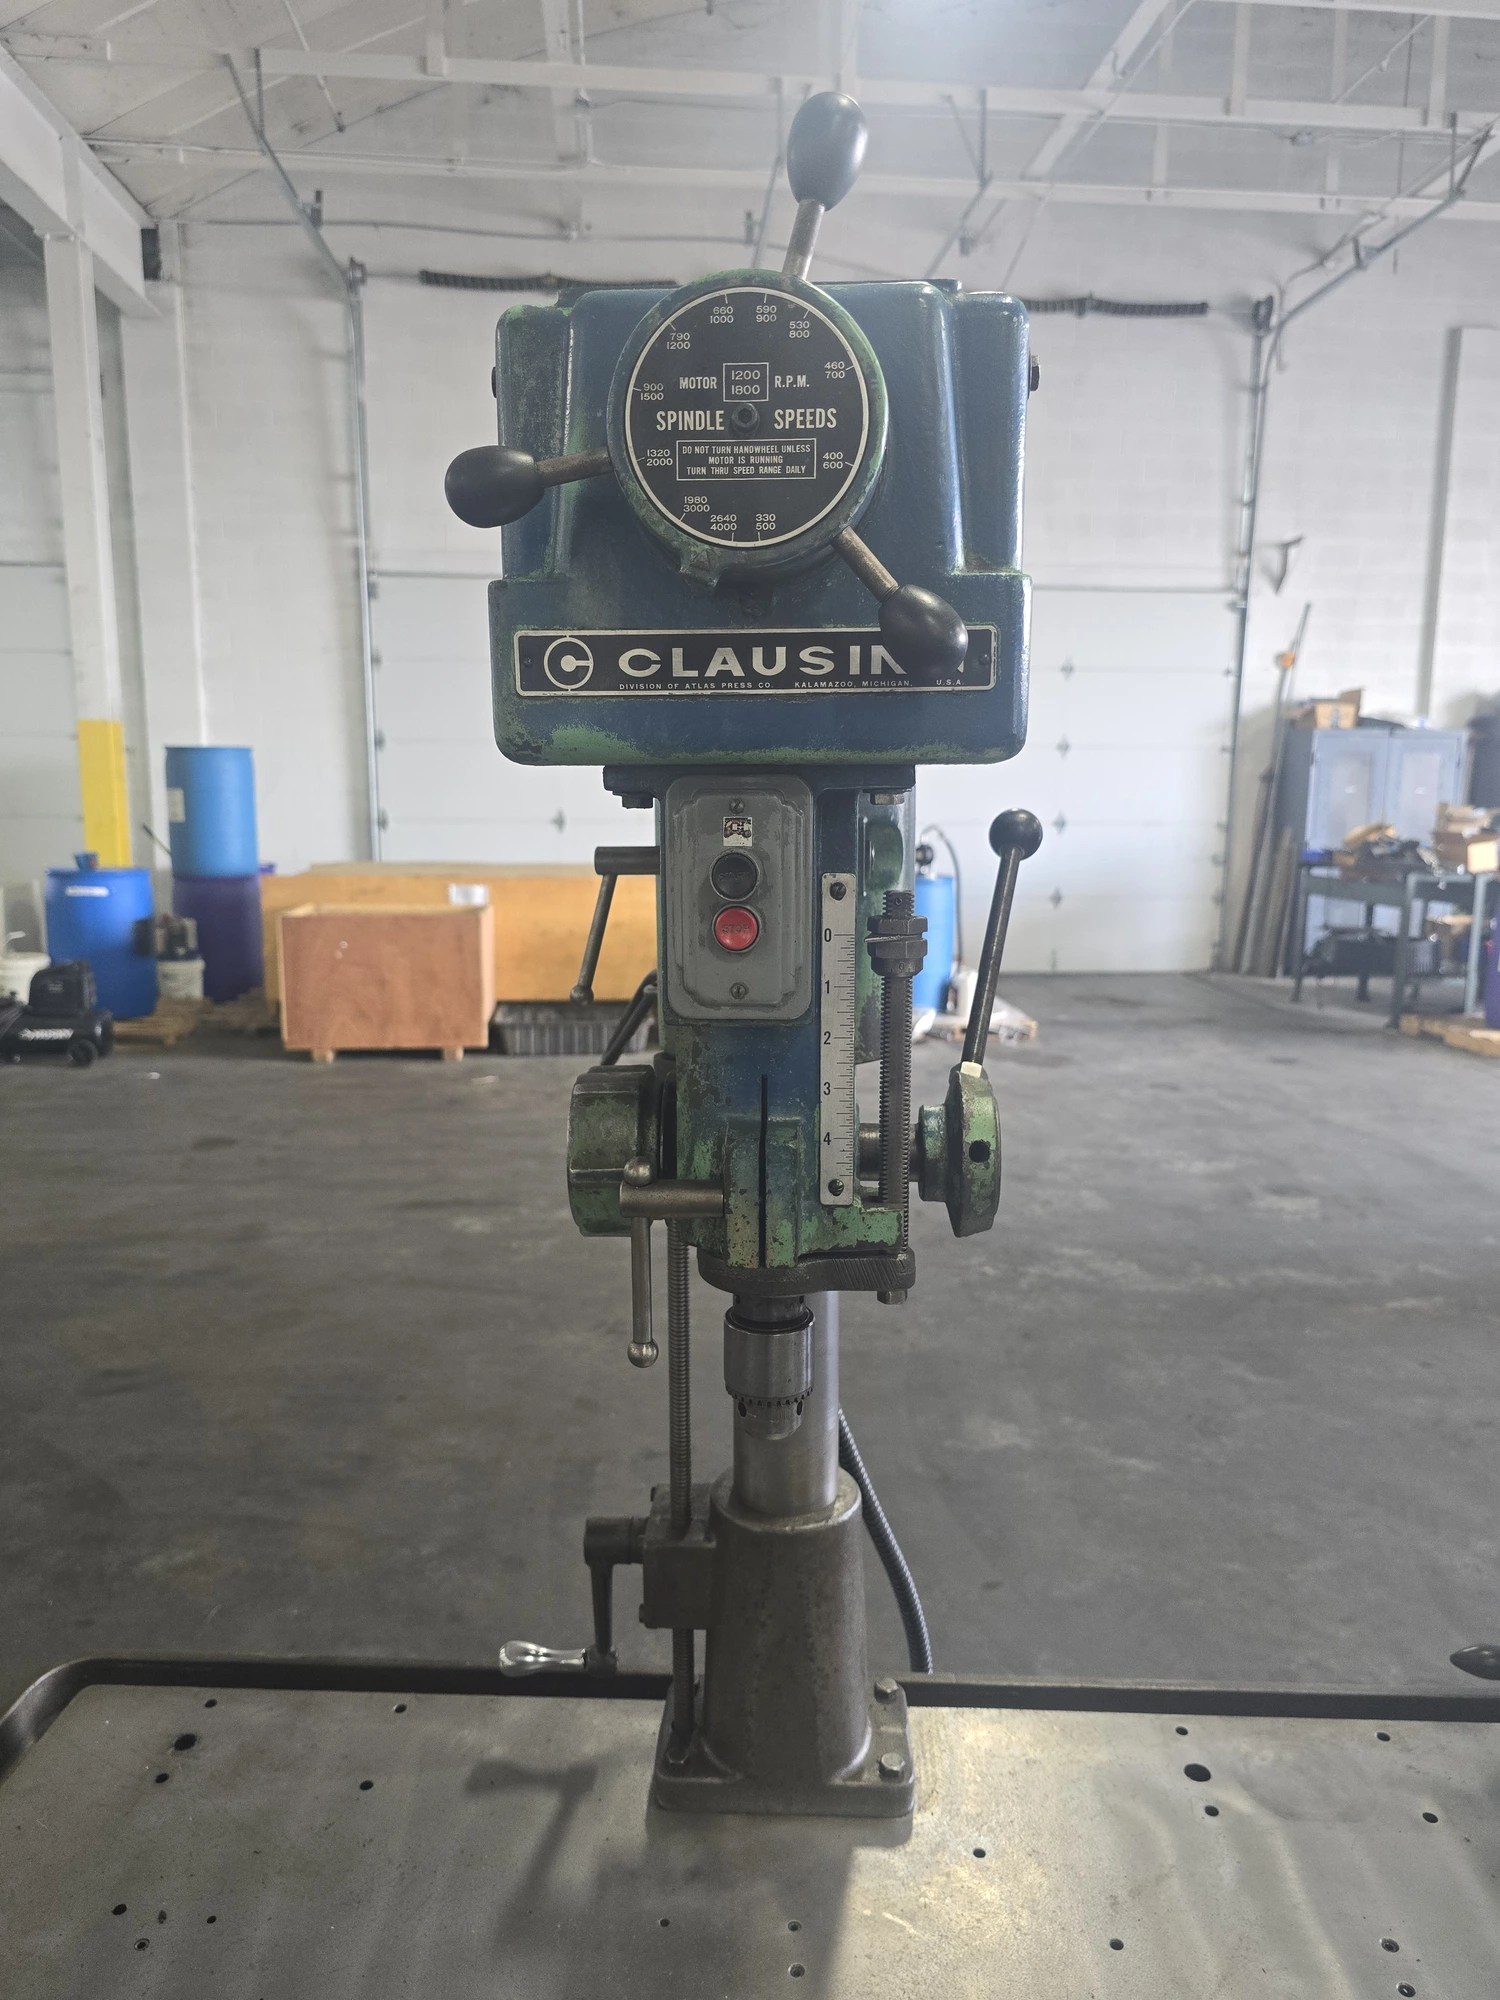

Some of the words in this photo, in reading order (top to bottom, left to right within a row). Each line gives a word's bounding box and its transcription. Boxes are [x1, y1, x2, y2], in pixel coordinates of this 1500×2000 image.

[713, 306, 733, 314] 660
[756, 305, 776, 313] 590
[710, 315, 734, 323] 1000
[756, 314, 776, 322] 900
[790, 321, 809, 329] 530
[789, 330, 809, 338] 800
[667, 341, 690, 349] 1200
[824, 361, 845, 369] 460
[732, 370, 760, 380] 1200
[825, 371, 845, 379] 700
[680, 377, 717, 389] MOTOR
[775, 375, 809, 387] R.P.M.
[644, 383, 663, 391] 900
[732, 385, 760, 394] 1800
[657, 411, 724, 430] SPINDLE
[774, 408, 836, 429] SPEEDS
[647, 449, 670, 457] 1320
[683, 446, 692, 455] DO
[695, 446, 709, 455] NOT
[712, 446, 731, 455] TURN
[734, 445, 779, 454] HANDWHEEL
[782, 445, 810, 454] UNLESS
[823, 452, 843, 460] 400
[647, 458, 673, 466] 2000
[709, 456, 734, 465] MOTOR
[738, 456, 745, 465] IS
[750, 456, 783, 464] RUNNING
[823, 461, 843, 469] 600
[687, 467, 706, 476] TURN
[711, 467, 728, 475] THRU
[733, 467, 754, 475] SPEED
[759, 466, 781, 474] RANGE
[786, 466, 806, 474] DAILY
[685, 496, 707, 504] 1980
[711, 514, 736, 522] 2640
[710, 523, 737, 531] 4000
[756, 522, 775, 530] 500
[618, 645, 964, 677] CLAUSIN
[685, 682, 715, 690] ATLAS
[722, 681, 752, 689] PRESS
[937, 678, 964, 686] U.S.A.
[824, 928, 831, 942] 0
[824, 980, 830, 994] 1
[824, 1031, 831, 1044] 2
[824, 1082, 830, 1095] 3
[824, 1132, 831, 1145] 4
